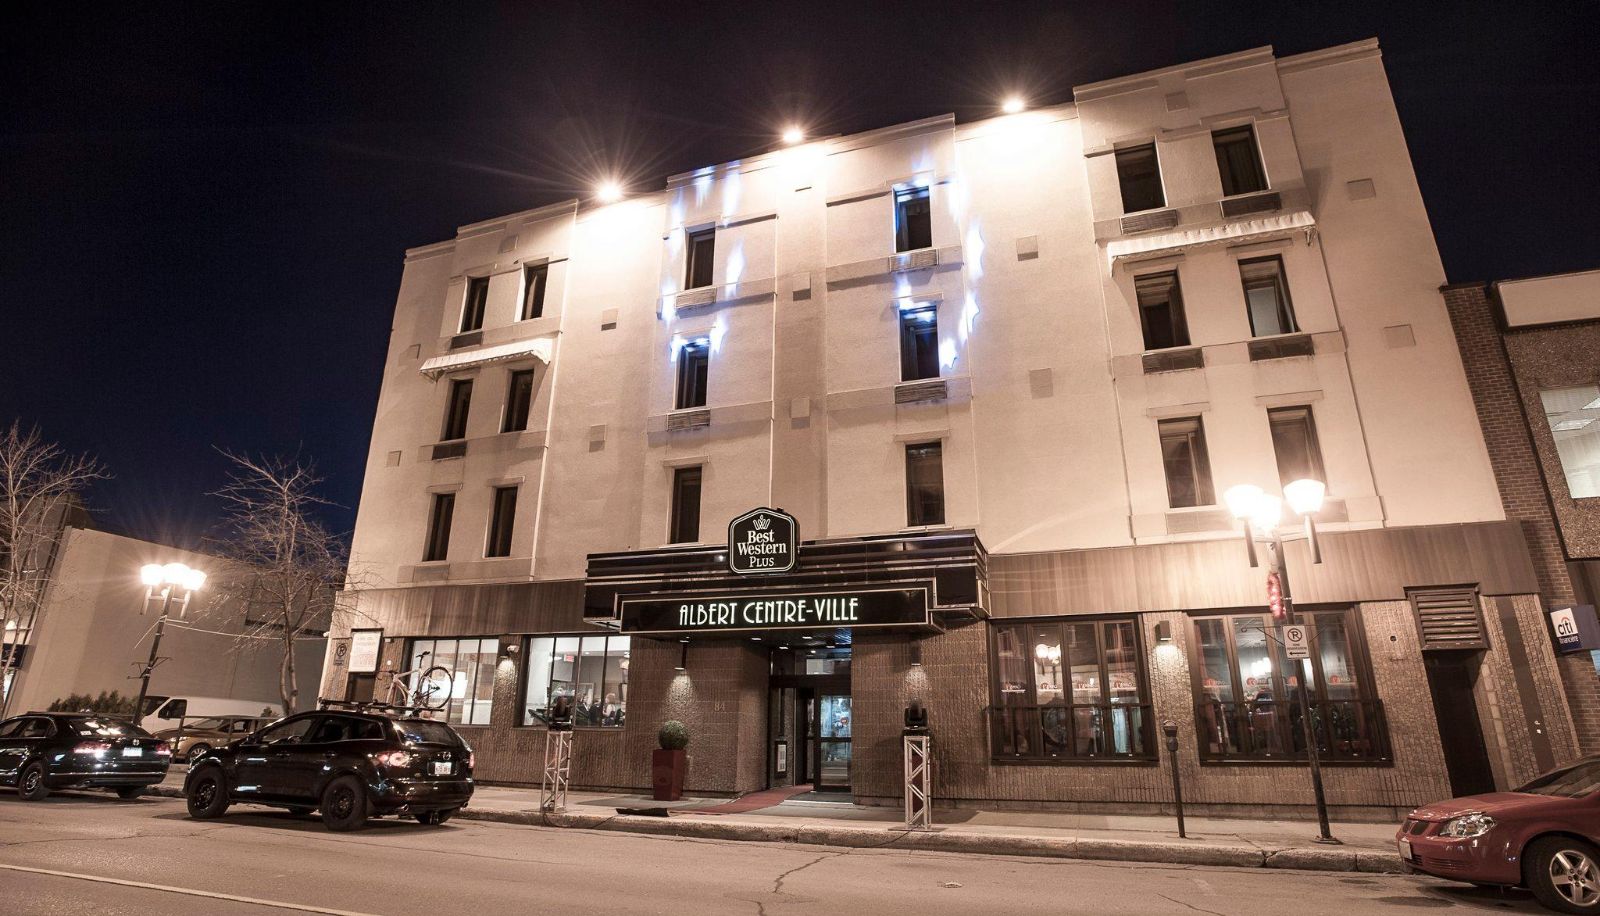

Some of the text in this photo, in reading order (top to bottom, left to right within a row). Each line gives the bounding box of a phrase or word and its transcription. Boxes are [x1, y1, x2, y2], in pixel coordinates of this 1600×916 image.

[747, 529, 775, 543] Best
[737, 541, 787, 556] Western
[749, 556, 774, 567] PLUS
[679, 598, 858, 626] ALBERT CENTRE-VILLE
[1558, 620, 1573, 635] citi
